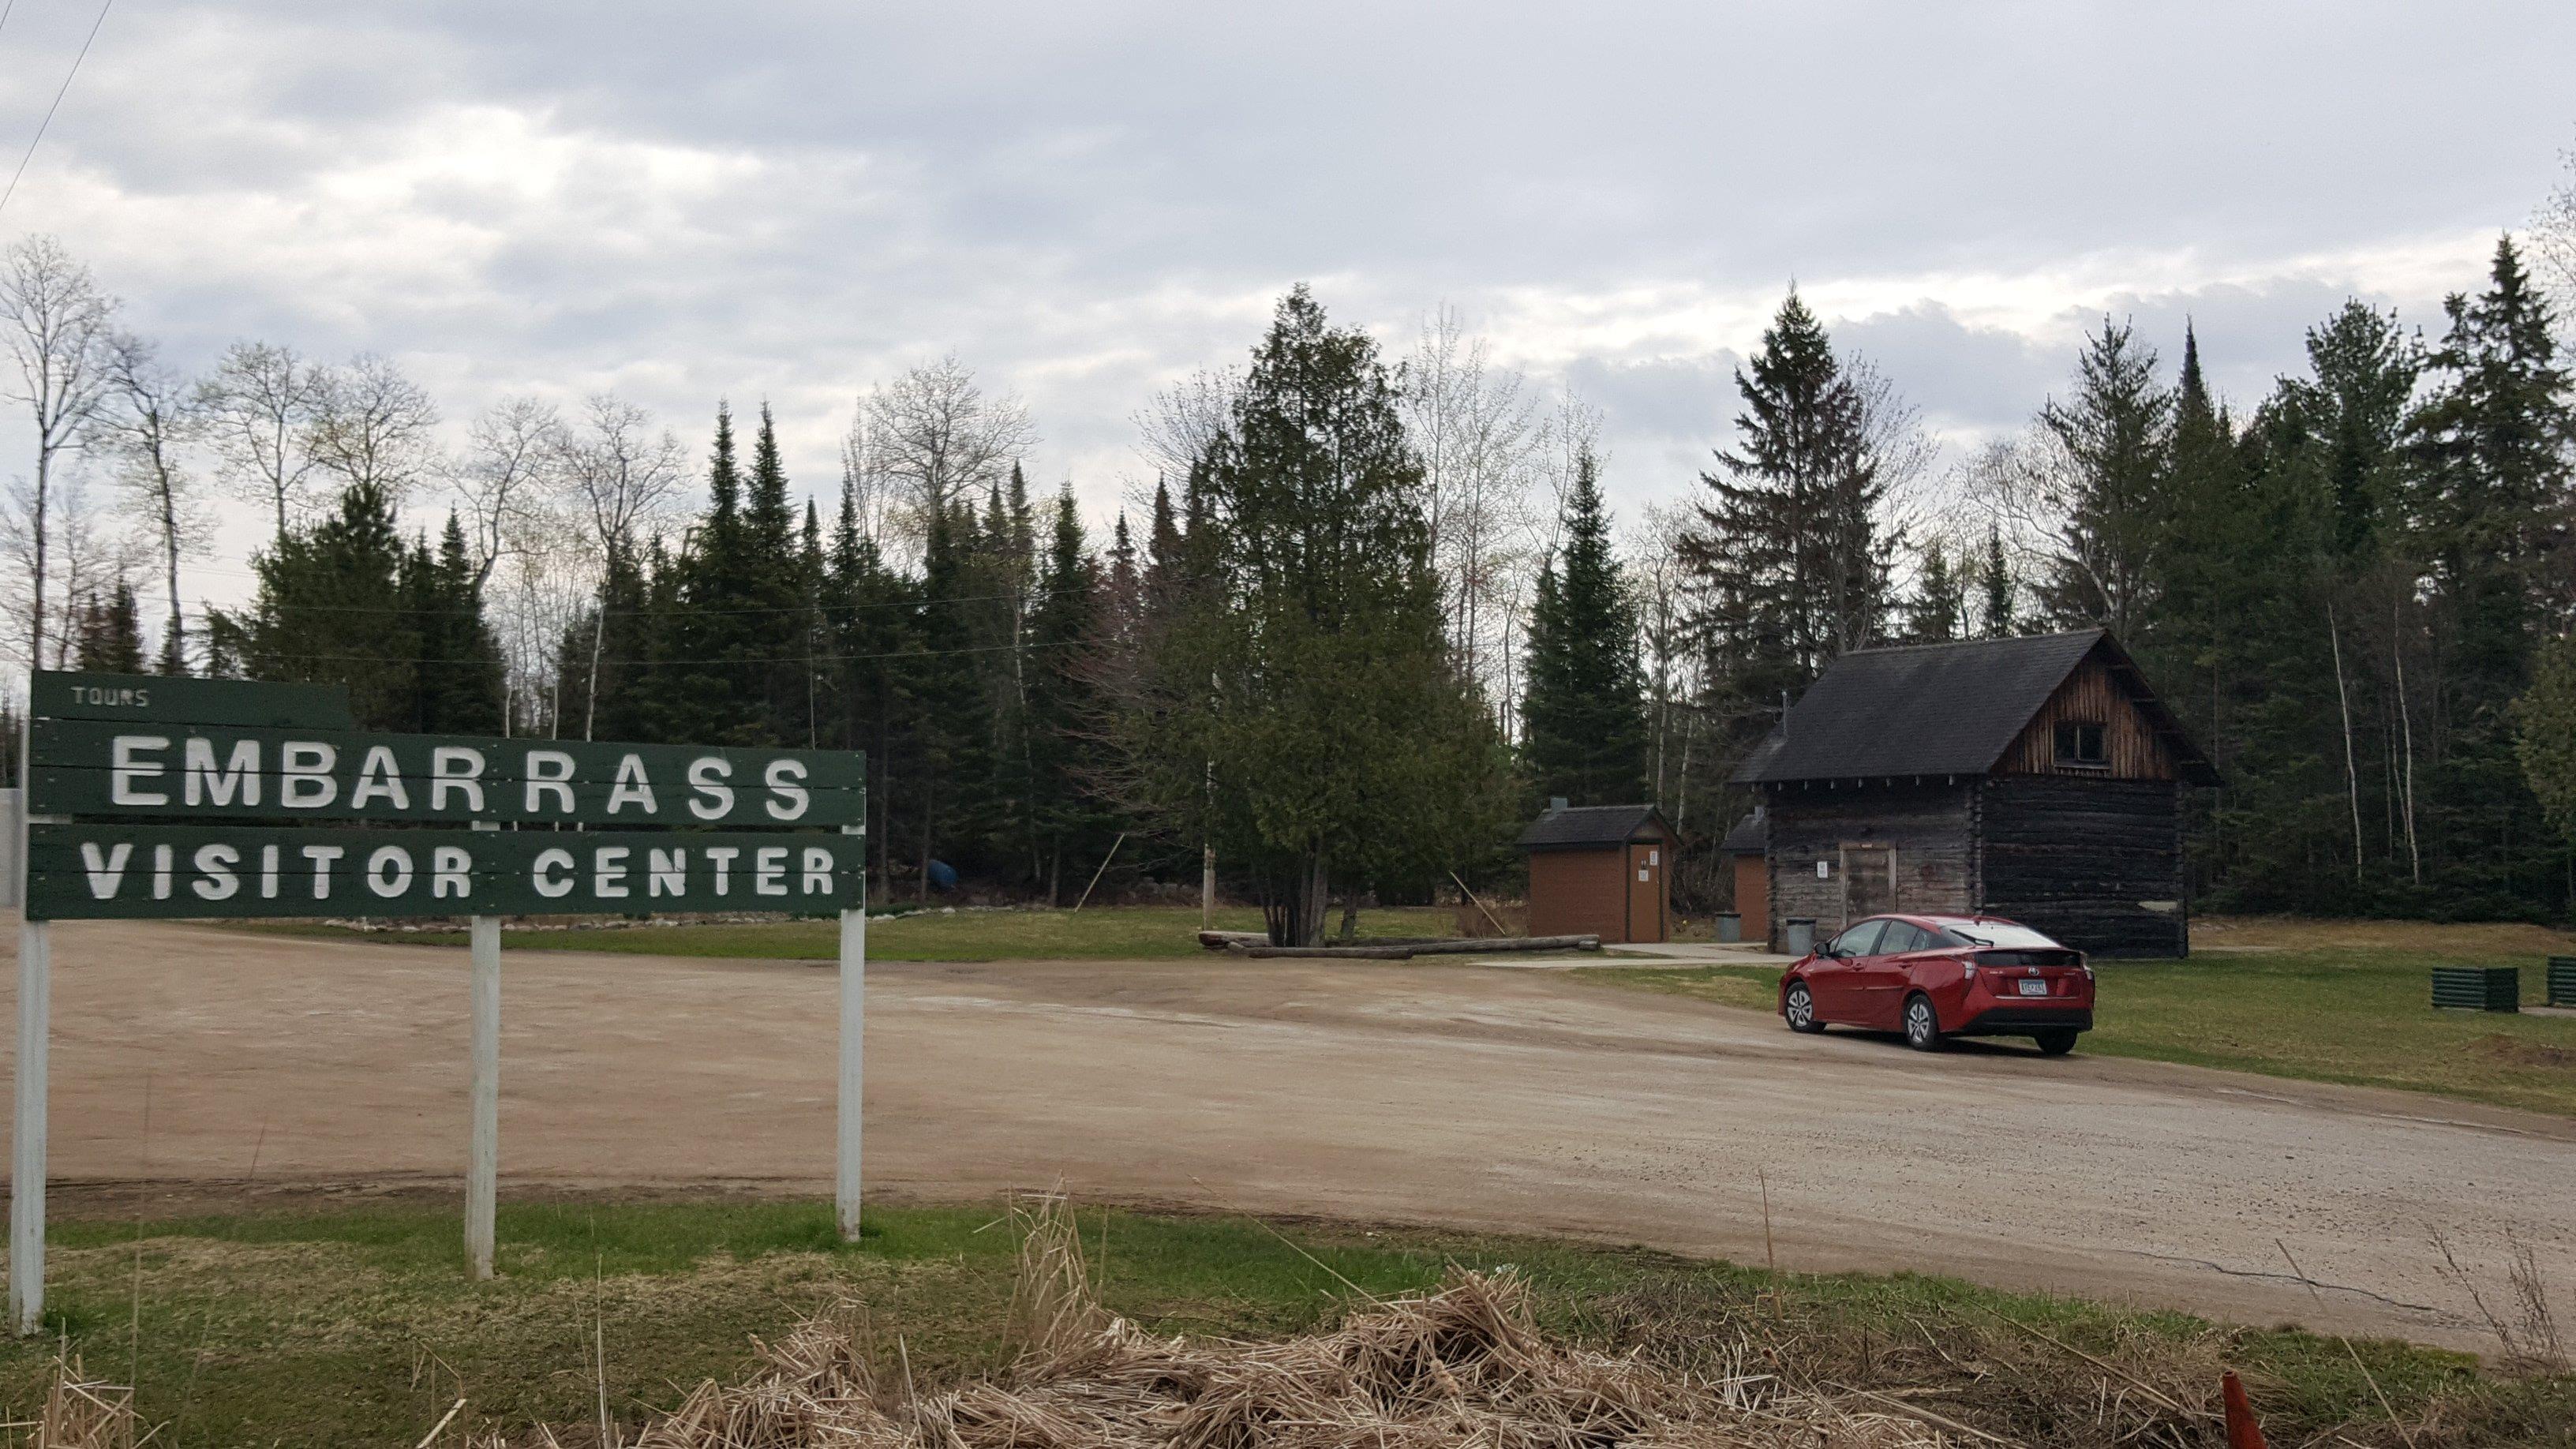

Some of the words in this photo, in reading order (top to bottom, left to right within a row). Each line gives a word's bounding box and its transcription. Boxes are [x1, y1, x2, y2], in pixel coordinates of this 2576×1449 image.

[70, 686, 150, 707] TOURS
[111, 735, 810, 822] EMBARRASS
[81, 842, 473, 901] VISITOR
[532, 847, 834, 898] CENTER
